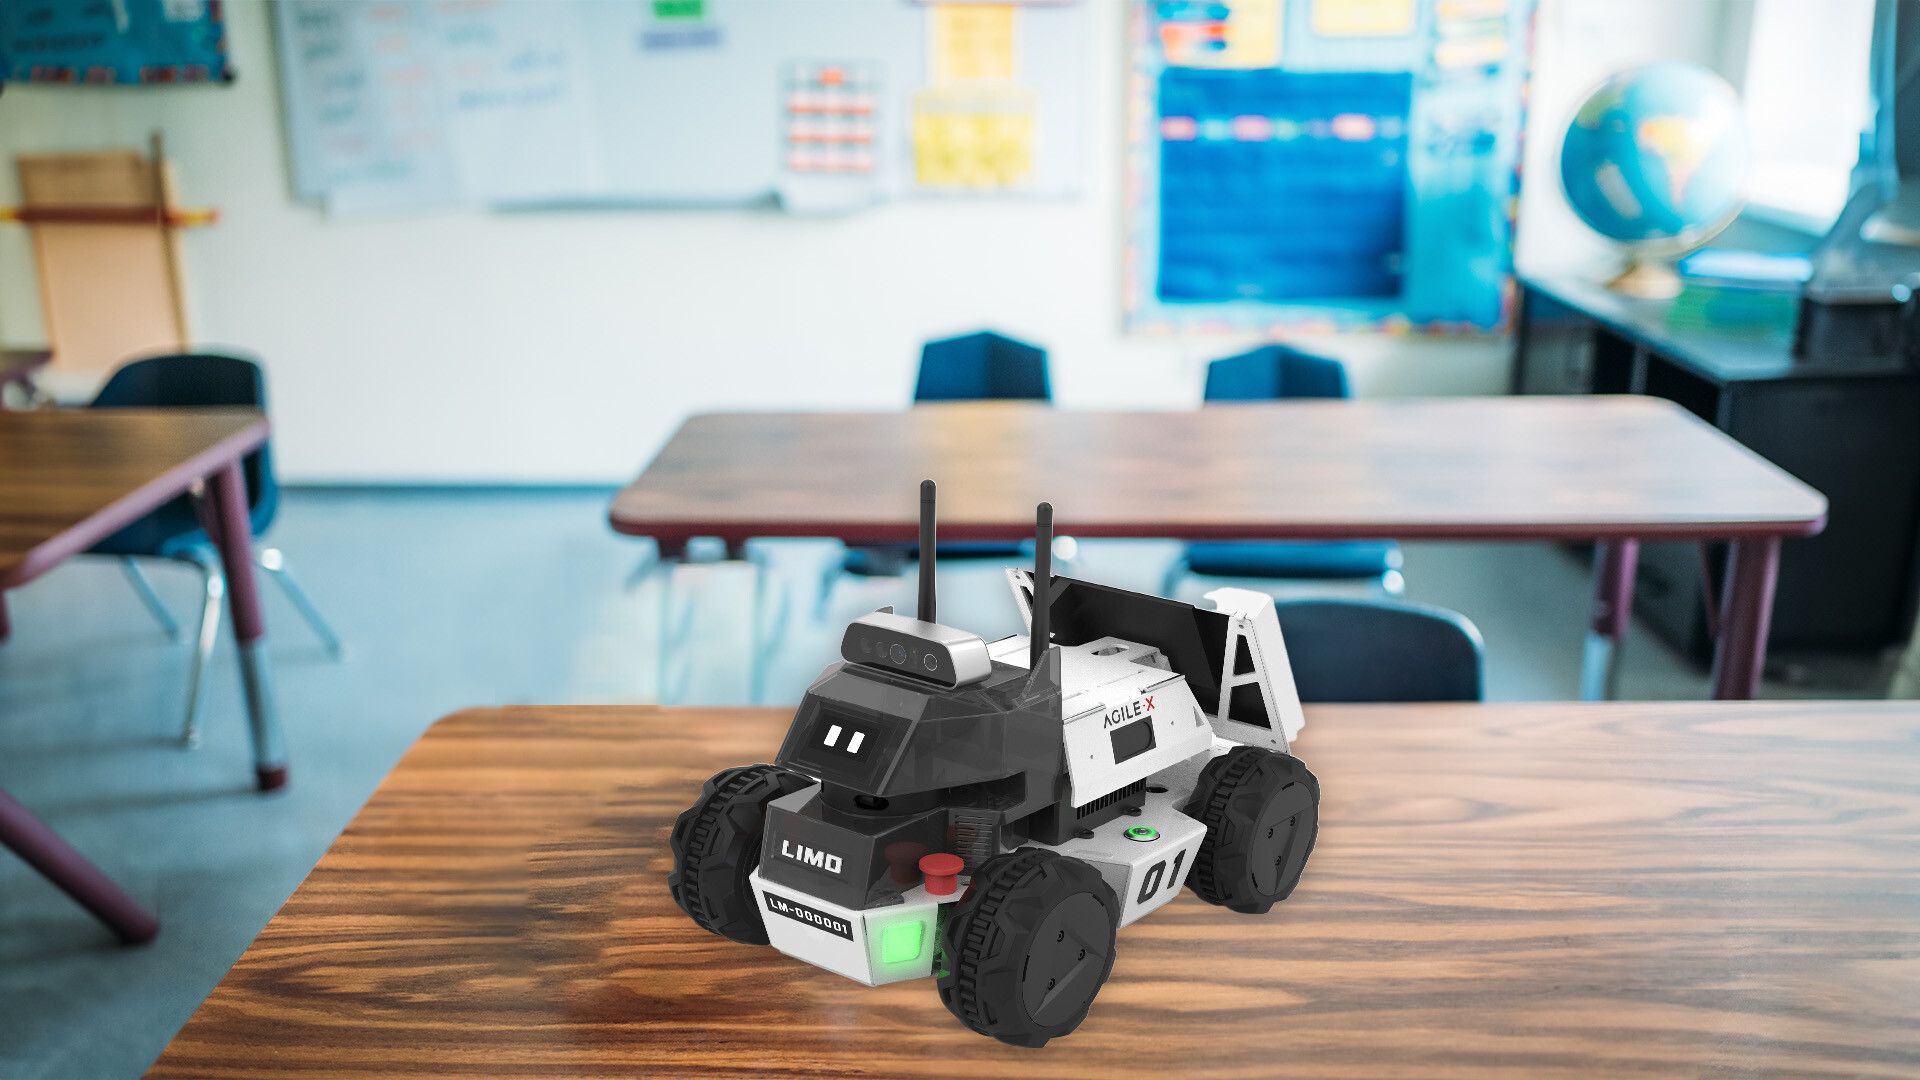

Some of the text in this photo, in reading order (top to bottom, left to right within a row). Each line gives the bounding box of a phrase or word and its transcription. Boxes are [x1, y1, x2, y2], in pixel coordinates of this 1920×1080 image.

[781, 839, 843, 874] LIMO
[1136, 848, 1187, 905] 01
[769, 897, 848, 934] LM-000001
